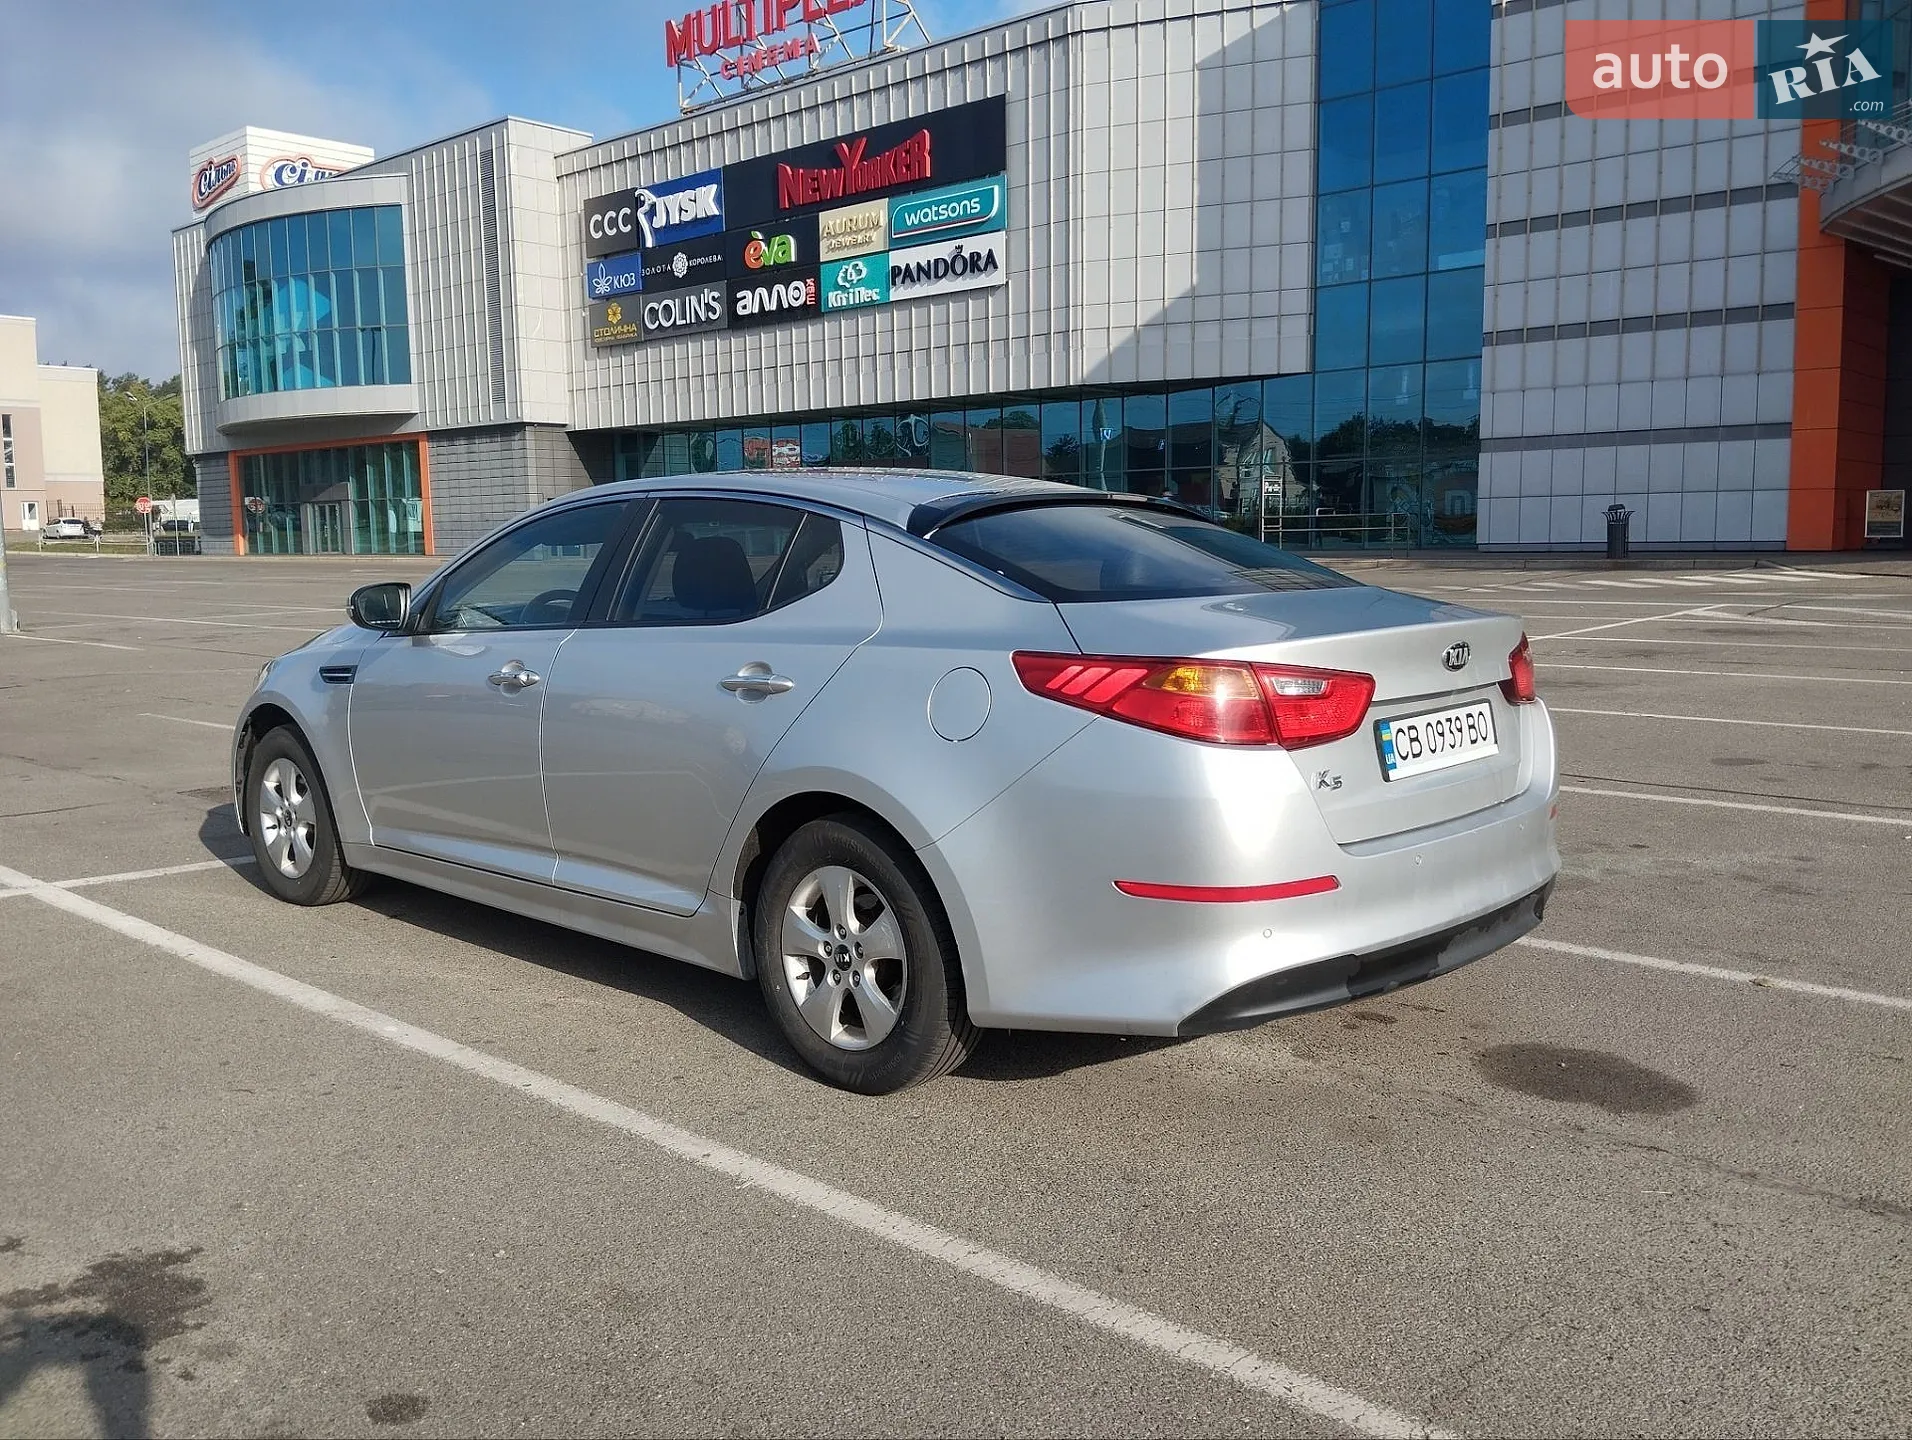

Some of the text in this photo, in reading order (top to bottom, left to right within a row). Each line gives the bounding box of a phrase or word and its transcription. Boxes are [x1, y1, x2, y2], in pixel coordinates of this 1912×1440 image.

[665, 0, 865, 67] MULTIPL
[720, 32, 821, 81] CINEMA
[652, 184, 720, 229] JYSK
[904, 197, 981, 227] watsons
[589, 207, 632, 239] CCC
[822, 209, 884, 238] AURUM
[641, 254, 723, 277] ЗОЛОТА КОРОЛЕВА
[890, 247, 999, 287] PANDORA
[613, 272, 636, 290] КЮЗ
[643, 288, 723, 330] COLIN'S
[593, 322, 638, 338] СТОЛИЧНА
[1448, 647, 1470, 666] KIA
[1395, 711, 1489, 761] CB 0939 BO
[1385, 753, 1396, 765] UA
[1317, 769, 1343, 791] K5
